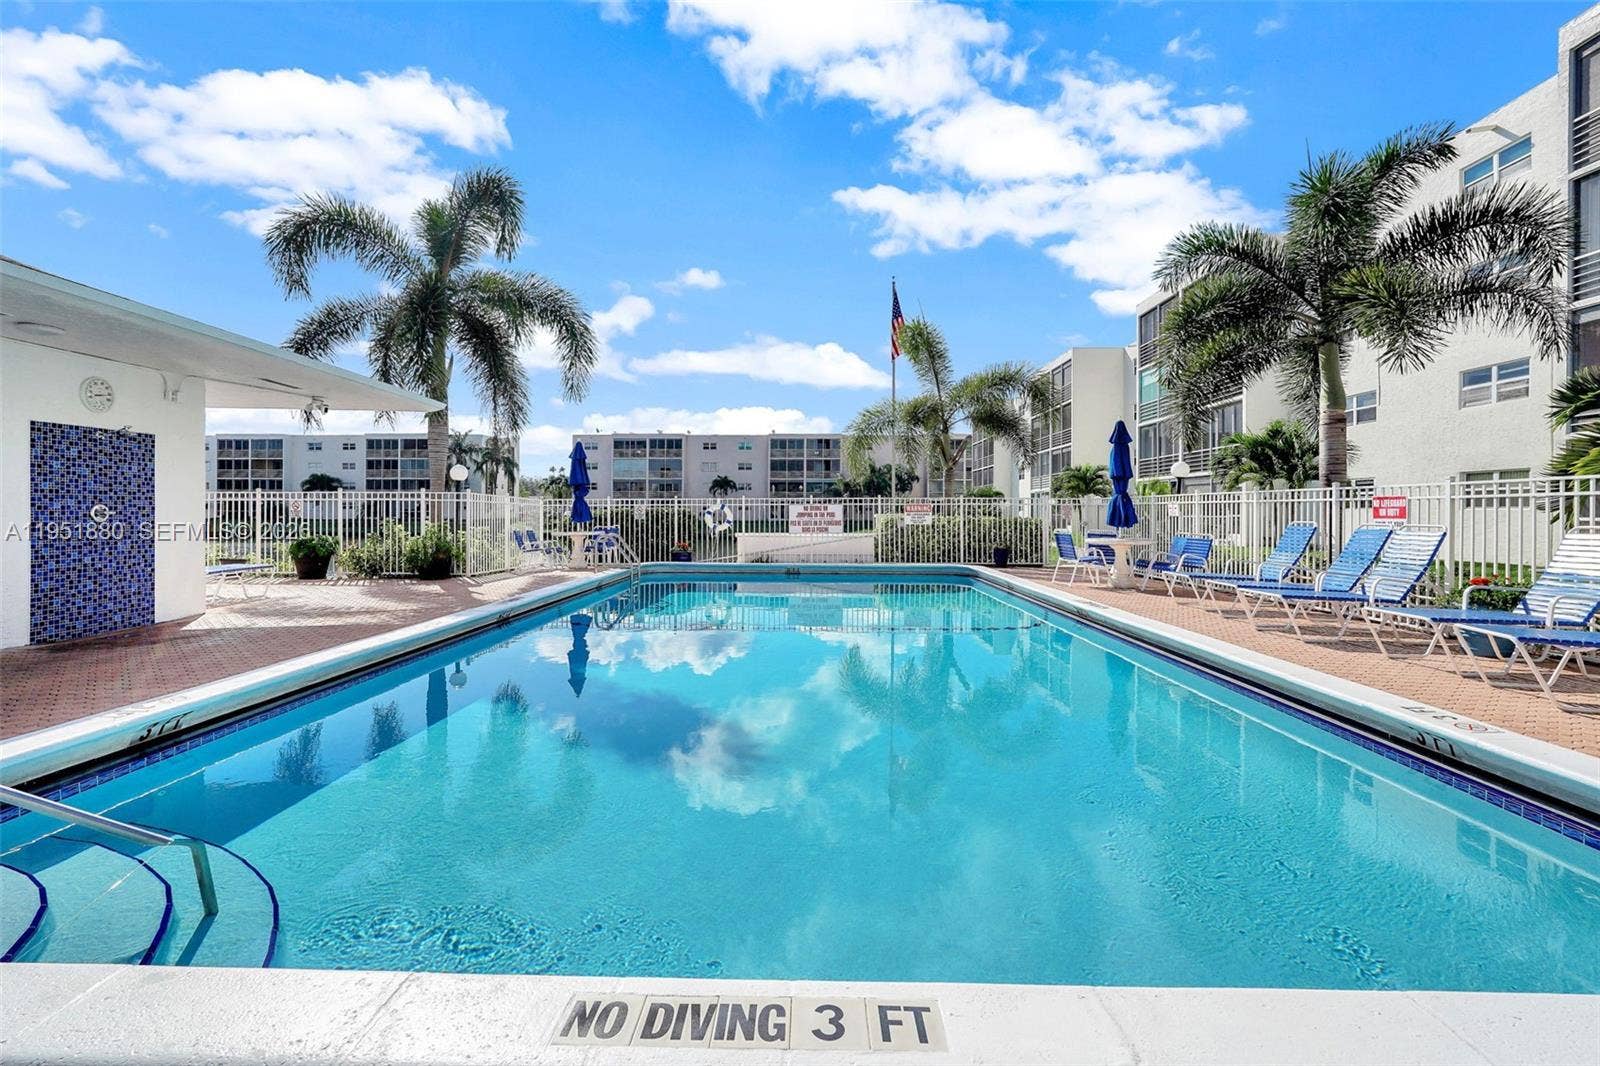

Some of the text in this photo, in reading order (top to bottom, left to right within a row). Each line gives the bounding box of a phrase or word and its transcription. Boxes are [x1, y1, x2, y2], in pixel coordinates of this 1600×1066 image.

[1380, 499, 1406, 507] LIFEGUARD
[1379, 508, 1400, 516] ON DUTY
[559, 1000, 931, 1044] NO DIVING 3 FT
